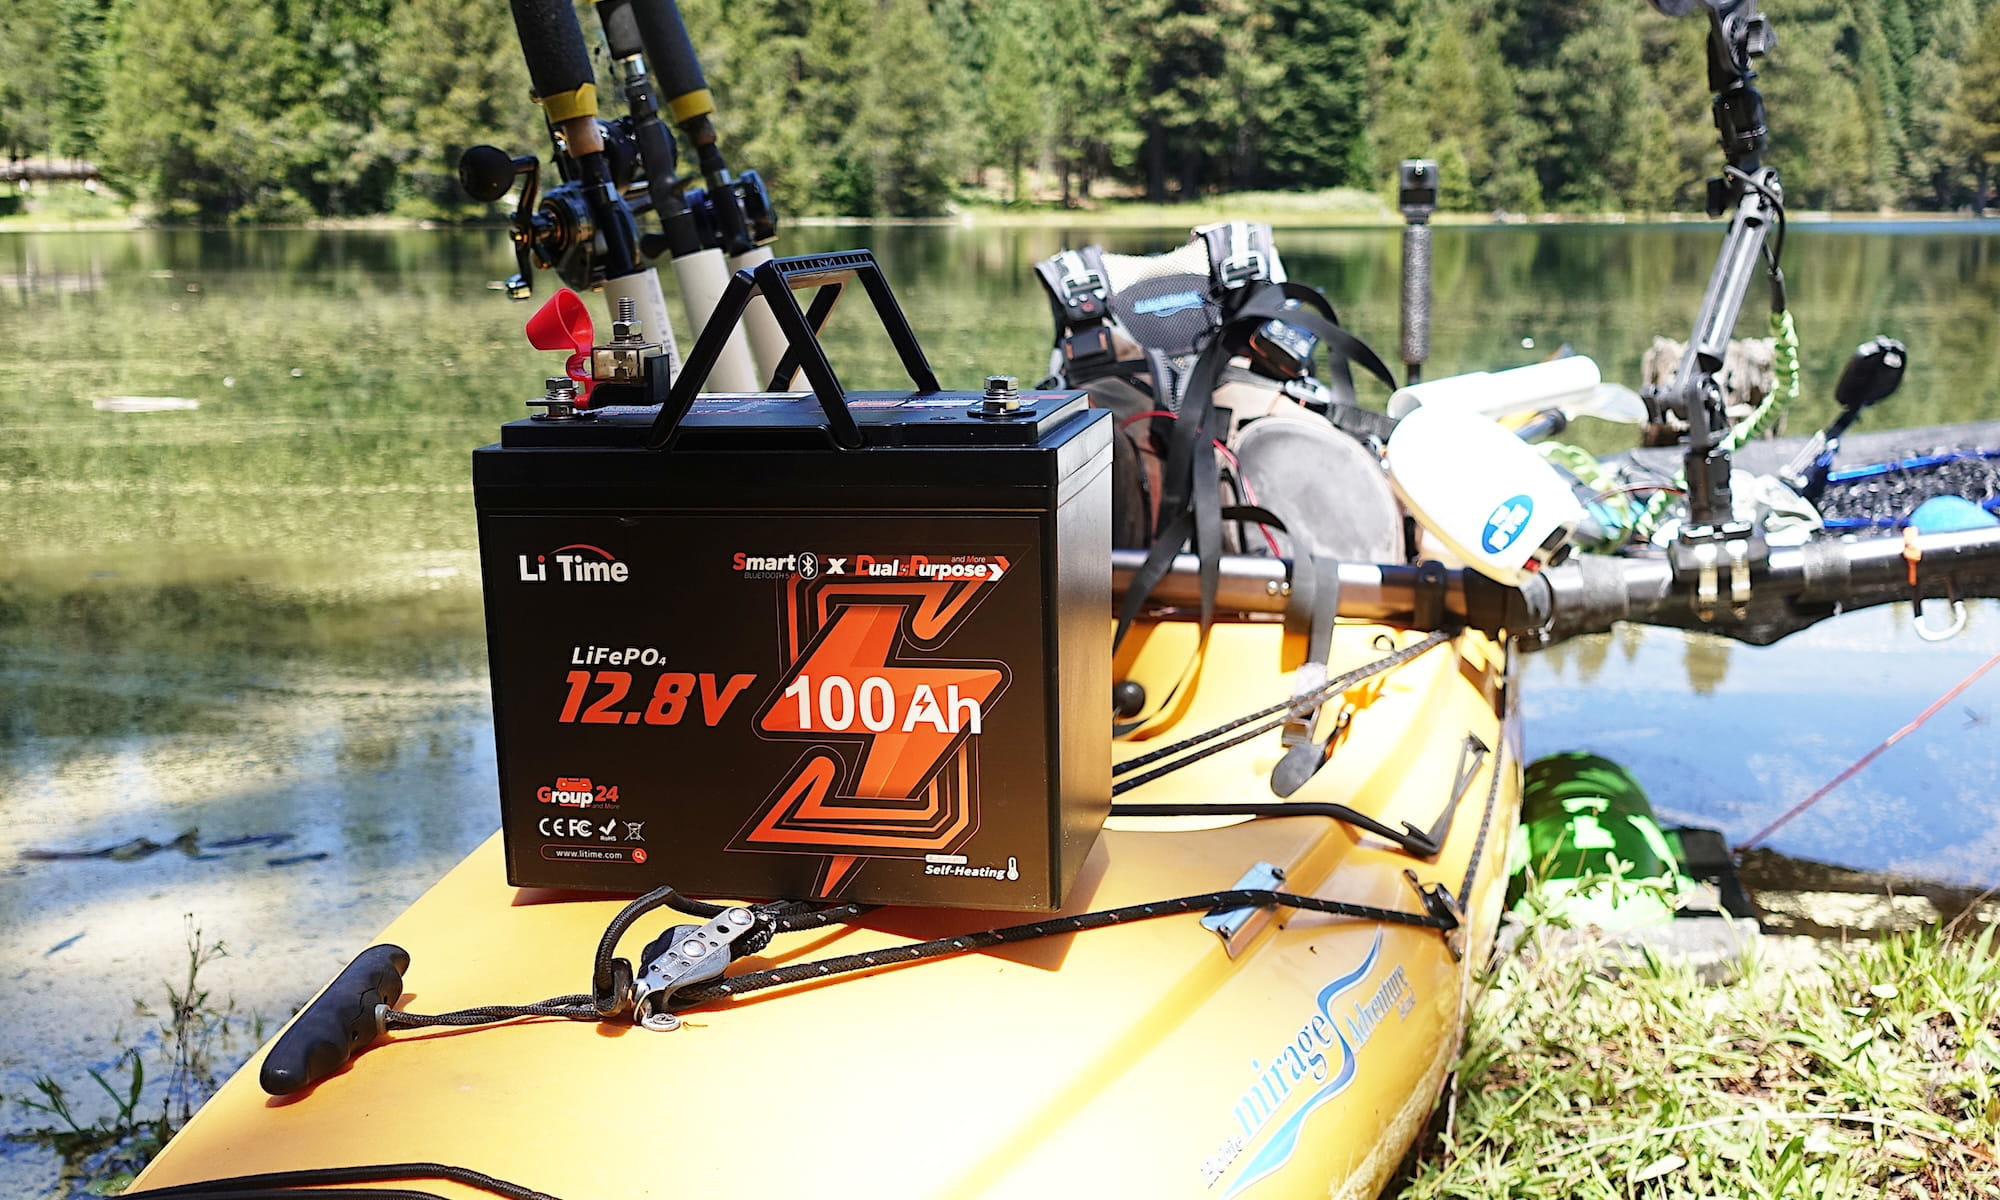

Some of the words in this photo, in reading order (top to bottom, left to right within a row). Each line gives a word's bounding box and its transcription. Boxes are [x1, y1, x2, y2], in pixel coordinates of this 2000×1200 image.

[519, 555, 546, 581] Li
[556, 555, 629, 582] Time
[732, 552, 797, 571] Smart
[855, 554, 900, 577] Dual
[910, 554, 988, 581] Purpose
[966, 555, 986, 563] More
[744, 572, 784, 580] BLUETOOTH
[571, 646, 667, 666] LiFePO4
[558, 670, 757, 727] 12.8V
[785, 674, 896, 733] 100
[901, 684, 981, 735] Ah
[537, 786, 593, 808] Group
[594, 785, 619, 802] 24
[556, 850, 623, 860] www.litime.com
[925, 865, 1006, 880] Self-Heating
[1344, 964, 1408, 1051] Adventure
[1232, 1014, 1332, 1137] mirage
